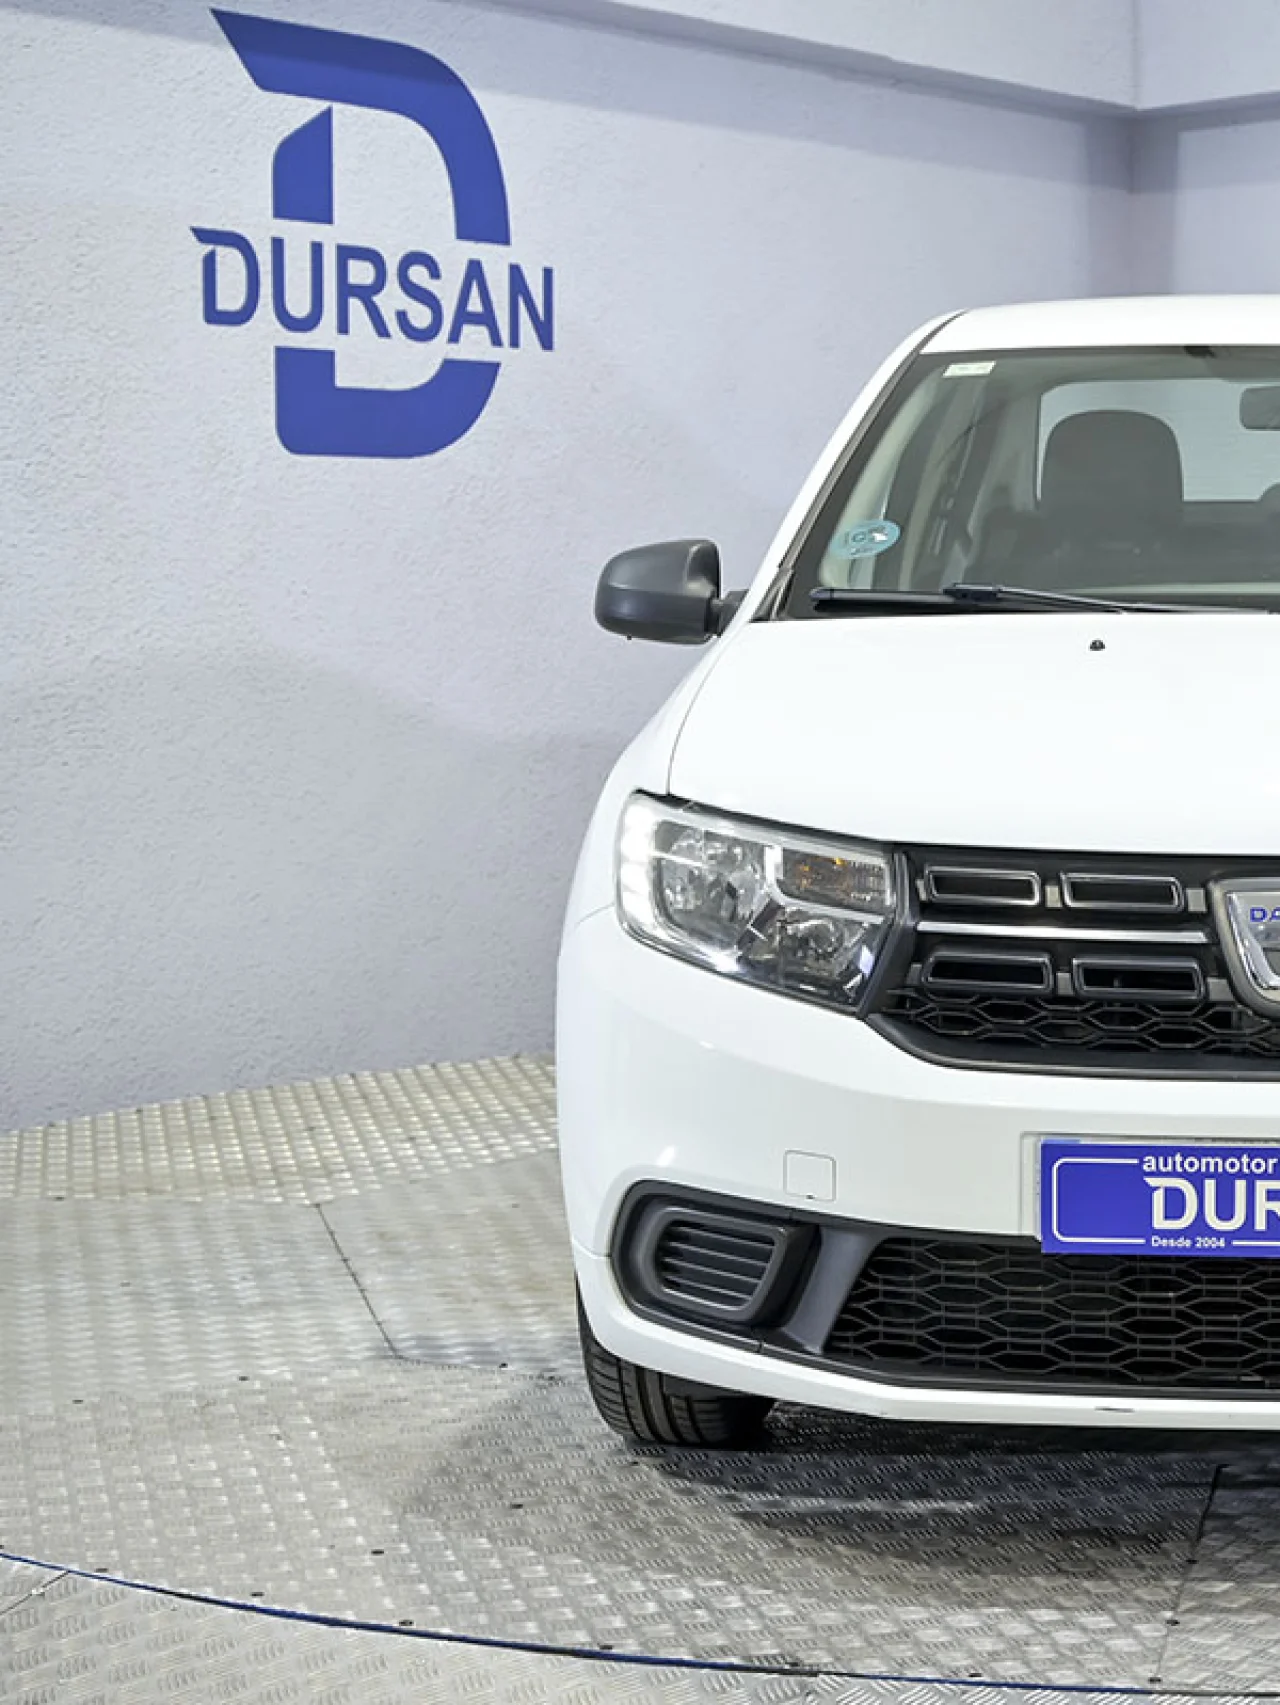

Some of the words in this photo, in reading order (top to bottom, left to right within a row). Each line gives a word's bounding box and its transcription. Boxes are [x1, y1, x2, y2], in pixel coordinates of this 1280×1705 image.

[190, 226, 554, 352] DURSAN
[1142, 1153, 1278, 1174] automotor
[1151, 1235, 1191, 1248] Desde
[1196, 1237, 1226, 1249] 2004
